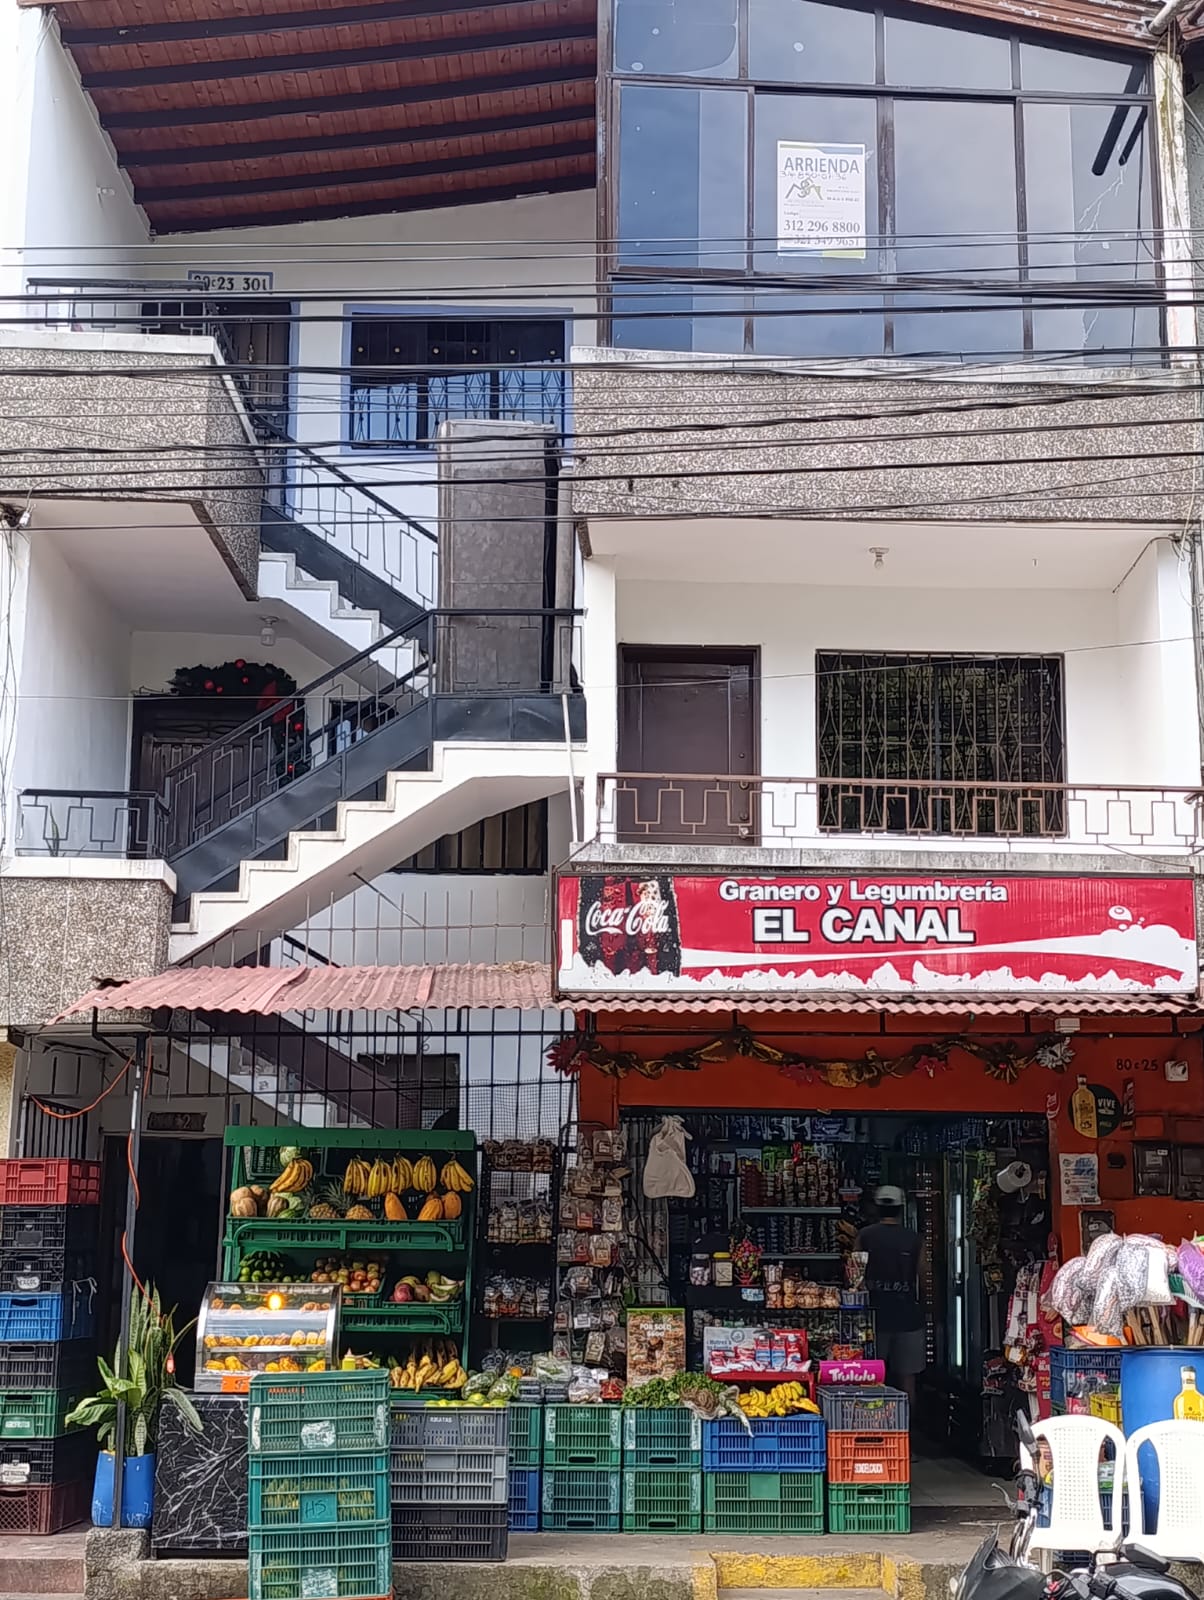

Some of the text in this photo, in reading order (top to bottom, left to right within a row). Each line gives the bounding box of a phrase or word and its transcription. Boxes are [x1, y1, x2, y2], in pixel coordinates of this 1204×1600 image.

[784, 157, 860, 174] ARRIENDA
[784, 219, 860, 233] 312 296 8800
[242, 277, 267, 291] 301
[719, 879, 1008, 905] Granero y Legumbrería
[585, 900, 670, 936] Coca-Cola
[753, 906, 977, 944] EL CANAL
[1097, 1098, 1116, 1109] VIVE
[828, 1368, 876, 1382] Trululu
